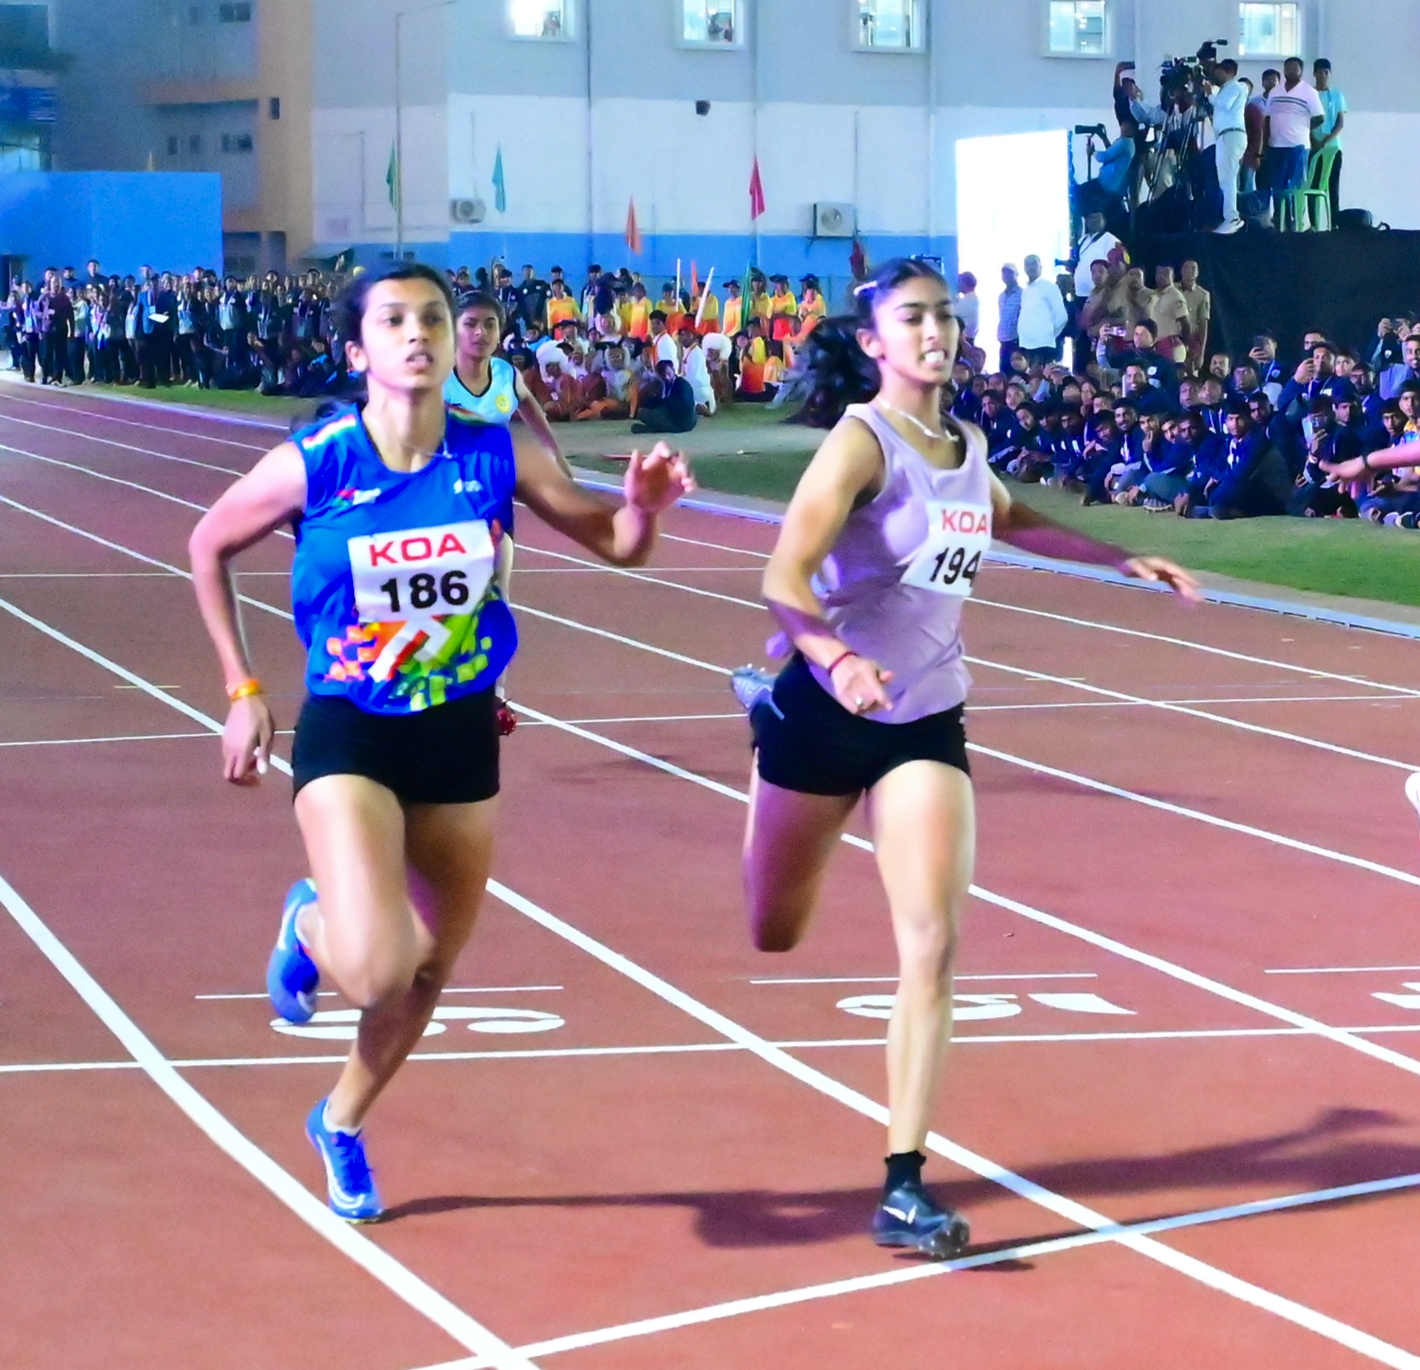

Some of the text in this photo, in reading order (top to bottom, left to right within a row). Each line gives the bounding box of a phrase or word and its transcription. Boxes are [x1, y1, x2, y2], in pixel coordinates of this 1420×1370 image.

[942, 508, 987, 534] KOA
[369, 533, 467, 567] KOA
[929, 547, 982, 587] 194
[380, 570, 469, 612] 186
